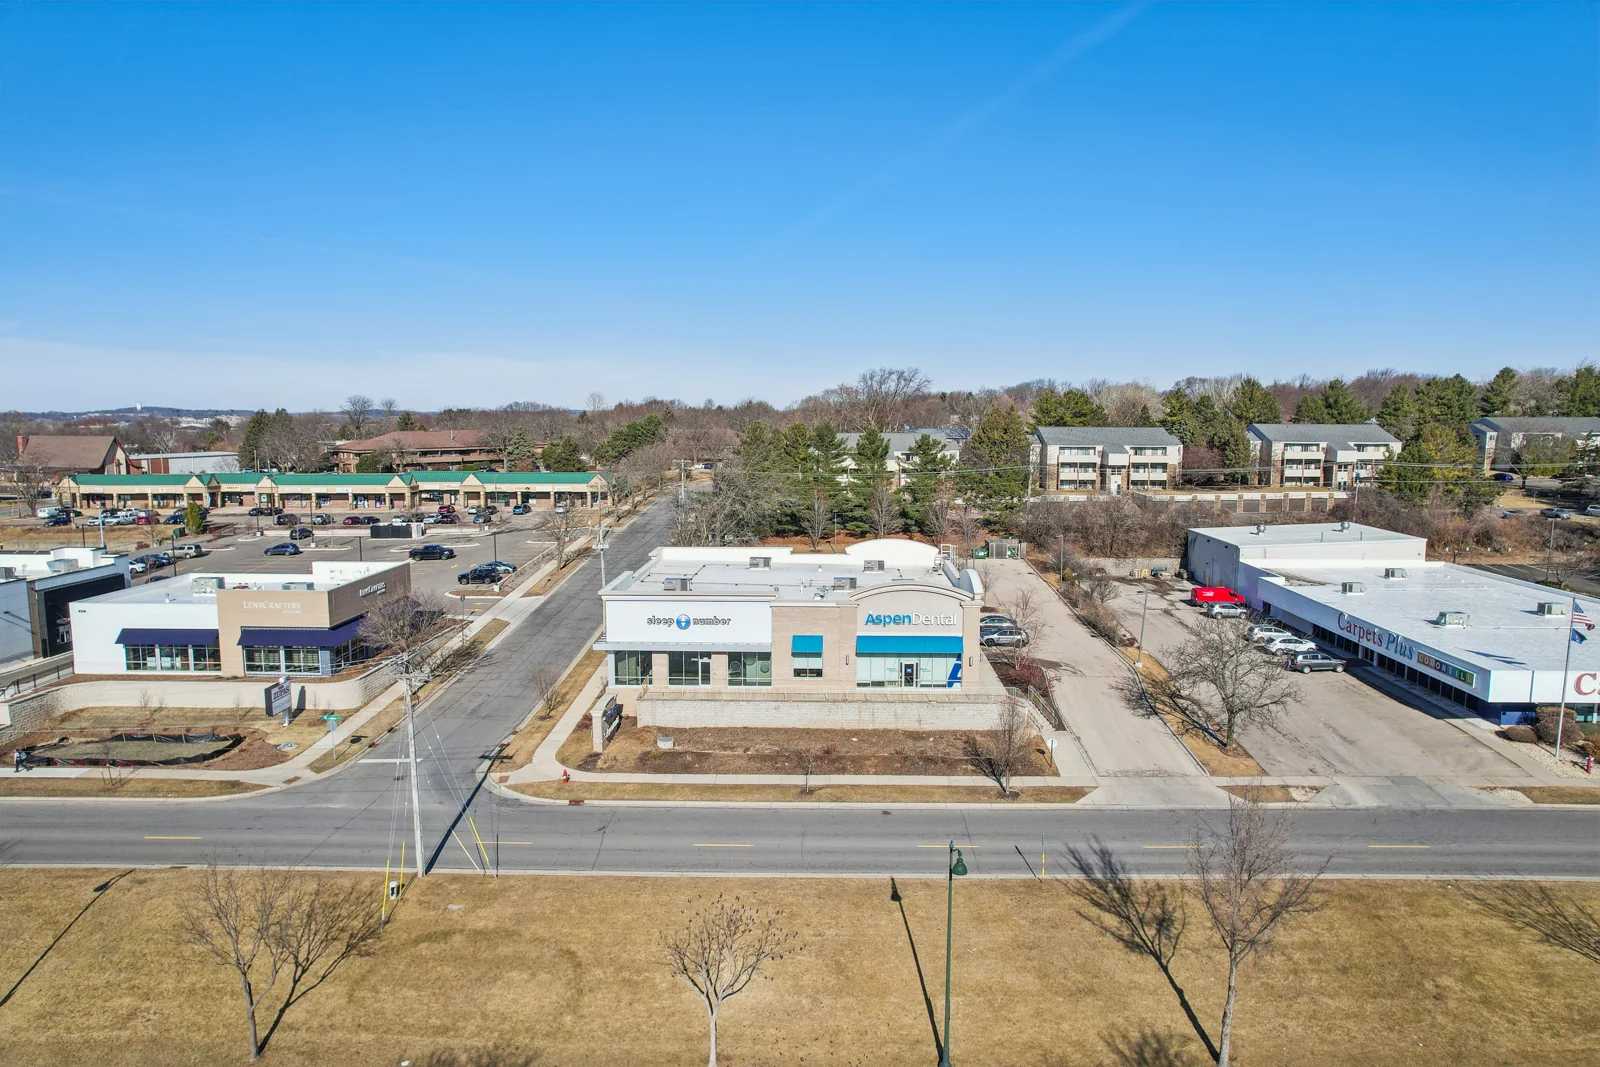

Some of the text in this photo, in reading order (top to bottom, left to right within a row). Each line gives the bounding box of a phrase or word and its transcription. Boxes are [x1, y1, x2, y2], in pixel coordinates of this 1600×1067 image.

[646, 615, 732, 628] sleep number
[1337, 612, 1416, 661] Carpets Plus
